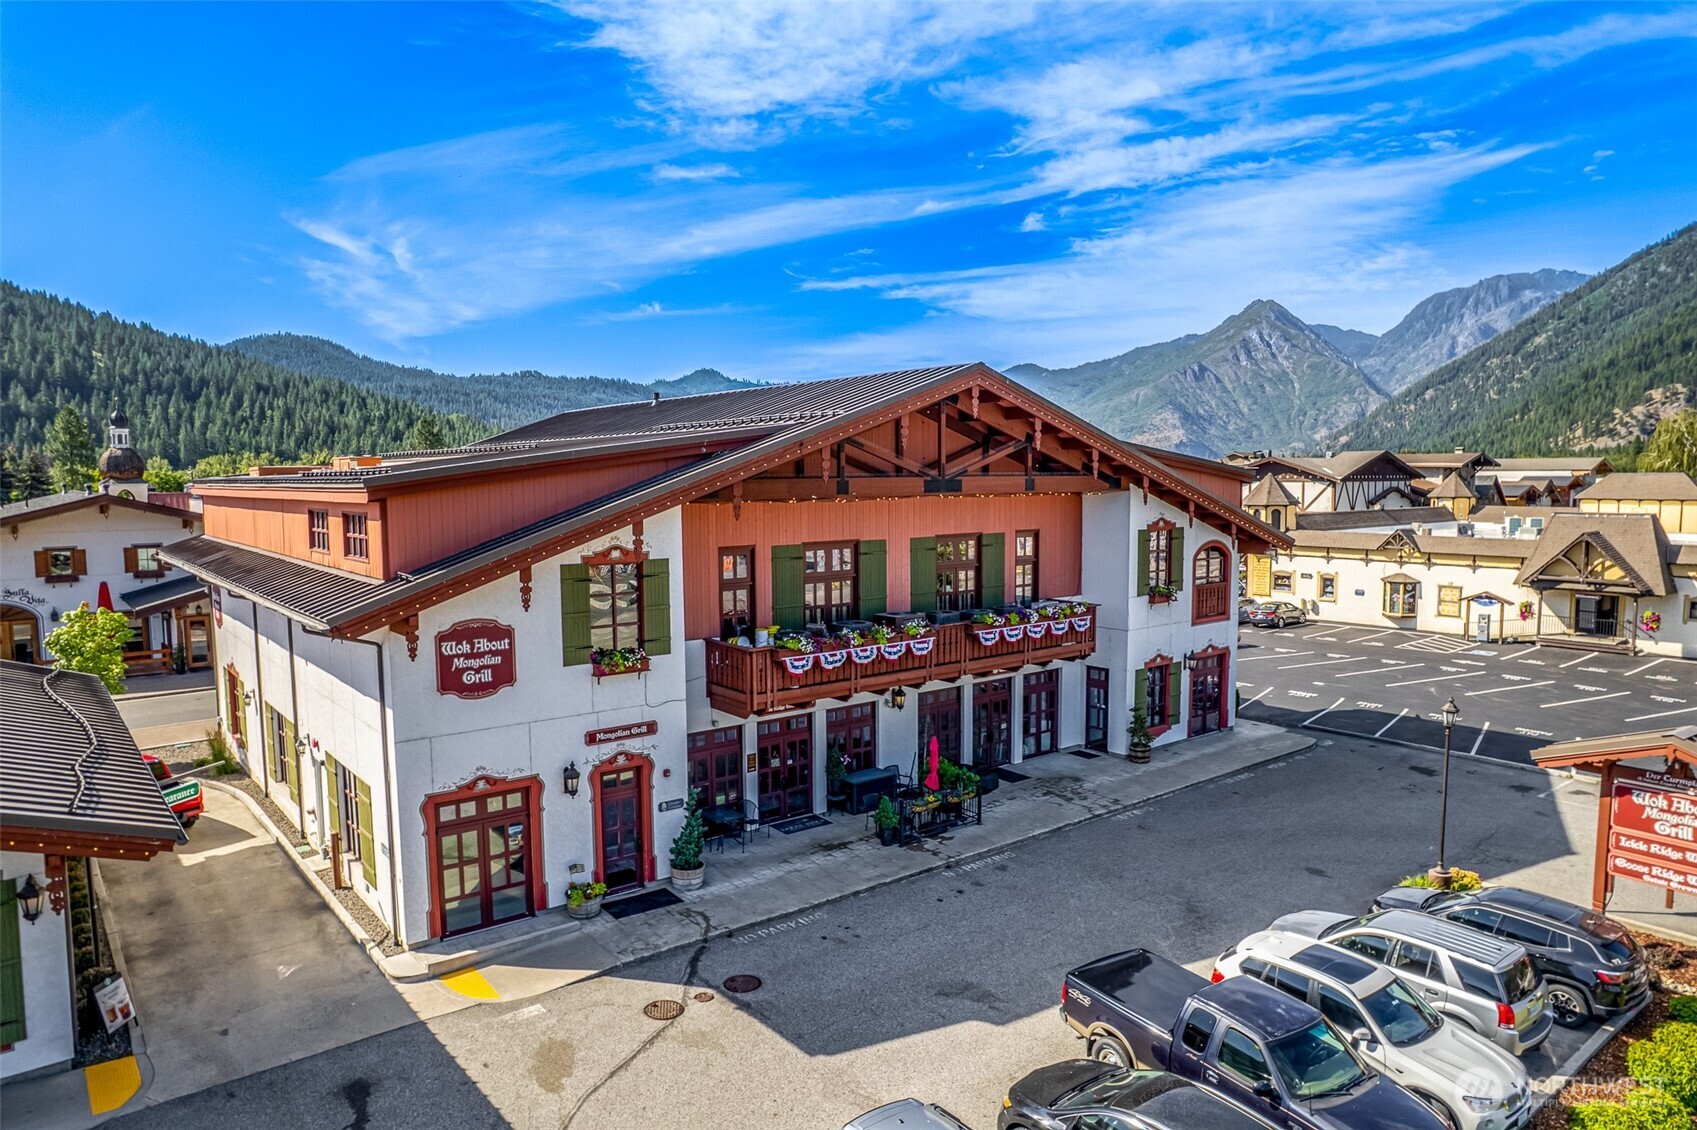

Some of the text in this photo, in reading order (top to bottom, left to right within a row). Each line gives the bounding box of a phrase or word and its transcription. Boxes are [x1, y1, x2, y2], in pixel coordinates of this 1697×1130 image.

[19, 595, 46, 605] Vita
[440, 637, 510, 656] Wok About
[451, 654, 502, 672] Mongolian
[462, 668, 493, 684] Grill
[596, 725, 647, 742] Mongolian Grill
[1645, 771, 1661, 781] Der
[1631, 789, 1668, 810] Wok
[1654, 821, 1694, 841] Grill
[1619, 835, 1649, 852] Icicle
[1649, 843, 1684, 861] Ridge
[1614, 857, 1650, 874] Goose
[1650, 865, 1686, 883] Ridge
